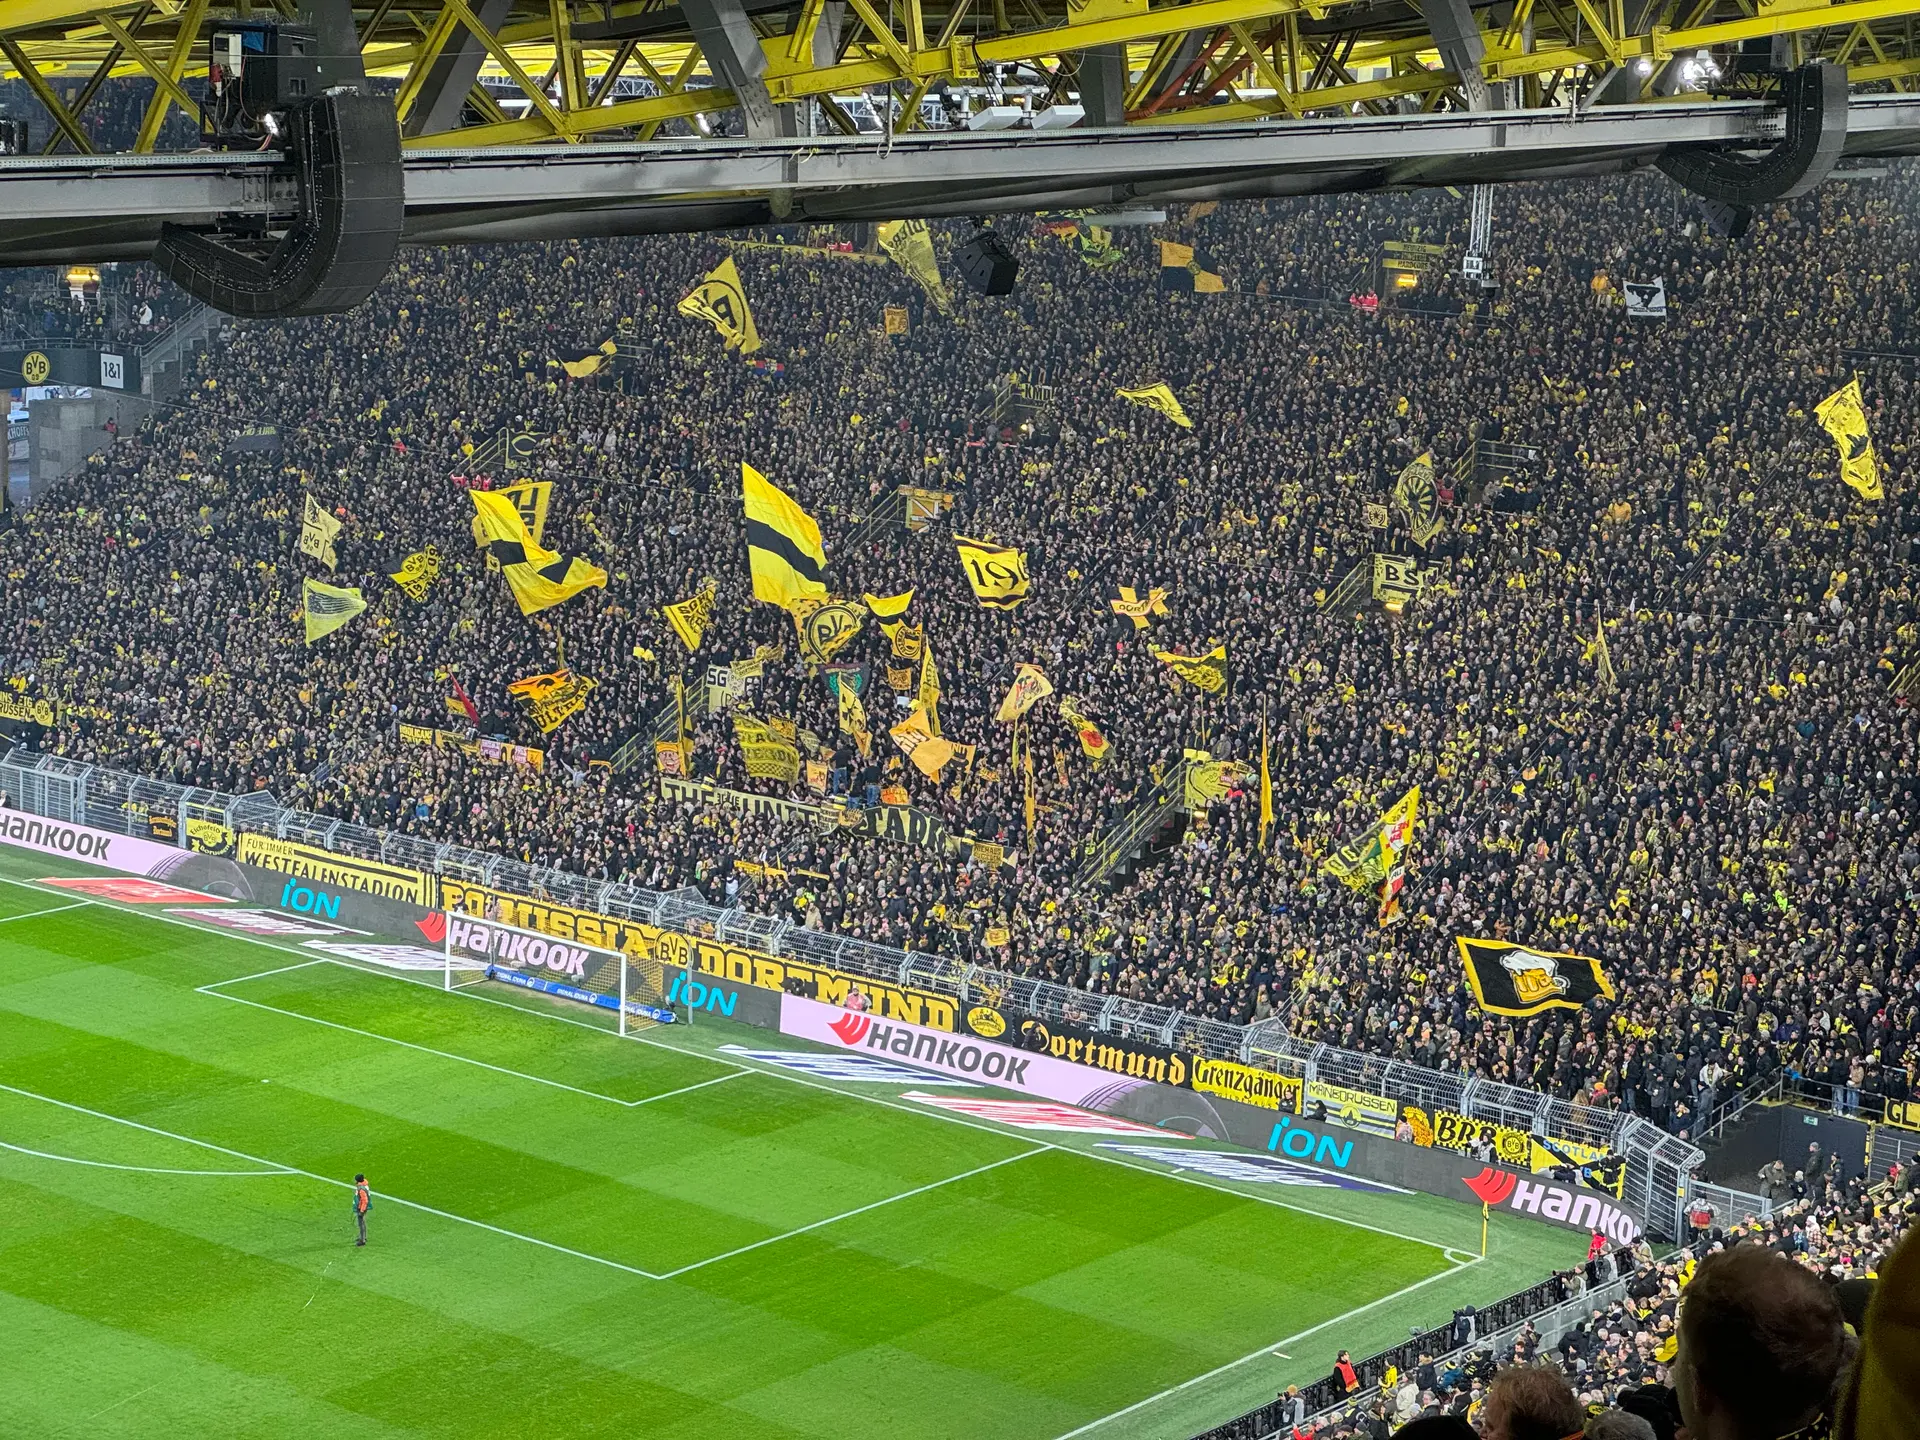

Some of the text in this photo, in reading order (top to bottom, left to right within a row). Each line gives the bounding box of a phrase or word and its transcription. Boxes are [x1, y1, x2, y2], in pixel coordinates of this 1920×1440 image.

[25, 355, 47, 375] BVB
[102, 361, 121, 380] 1&1
[405, 554, 424, 572] BVB
[36, 701, 49, 716] BVB
[246, 837, 295, 856] FÜR IMMER
[659, 935, 689, 966] BVB
[1021, 1020, 1186, 1086] Dortmund
[1194, 1060, 1301, 1100] Grenzgänger
[1887, 1100, 1920, 1128] GL
[1542, 1139, 1606, 1164] SCOTLAN
